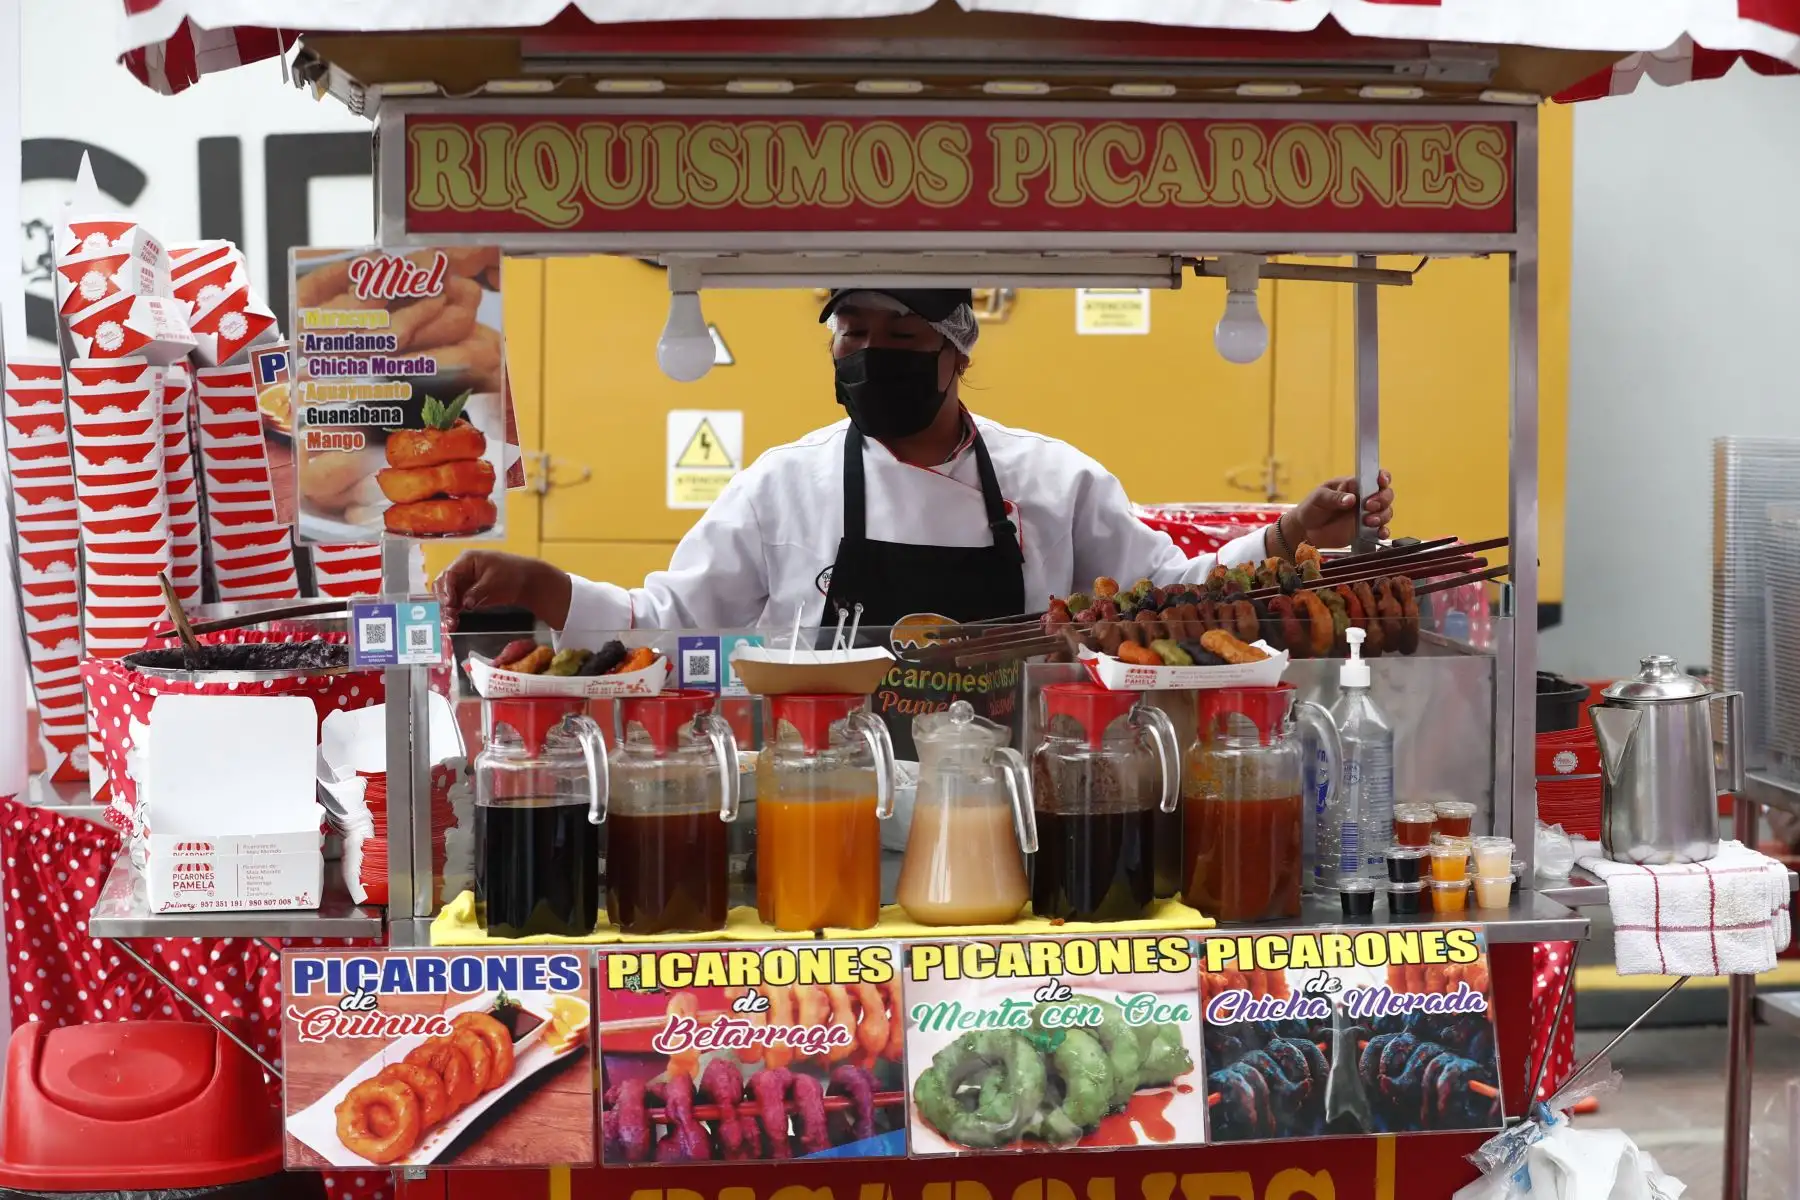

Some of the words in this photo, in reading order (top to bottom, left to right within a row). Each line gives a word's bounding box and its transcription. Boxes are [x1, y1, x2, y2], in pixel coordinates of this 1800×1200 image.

[409, 121, 972, 228] RIQUISIMOS
[988, 121, 1509, 208] PICARONES
[350, 251, 448, 300] Miel
[305, 333, 396, 352] Arandanos
[308, 358, 368, 376] Chicha
[371, 356, 436, 375] Morada
[306, 406, 402, 425] Guanabana
[306, 431, 365, 450] Mango
[172, 873, 215, 881] PICARONES
[172, 881, 215, 890] PAMELA
[911, 936, 1192, 981] PICARONES
[1204, 929, 1479, 972] PICARONES
[293, 954, 582, 996] PICARONES
[607, 946, 894, 989] PICARONES
[1305, 970, 1342, 994] de
[339, 987, 377, 1011] de
[732, 989, 770, 1012] de
[1034, 979, 1072, 1002] de
[1206, 989, 1331, 1026] Chicha
[1343, 982, 1489, 1020] Morada
[287, 1005, 453, 1043] Quinua
[911, 998, 1032, 1034] Menta
[1040, 1000, 1104, 1030] con
[1114, 992, 1192, 1027] Oca
[652, 1014, 853, 1054] Betarraga
